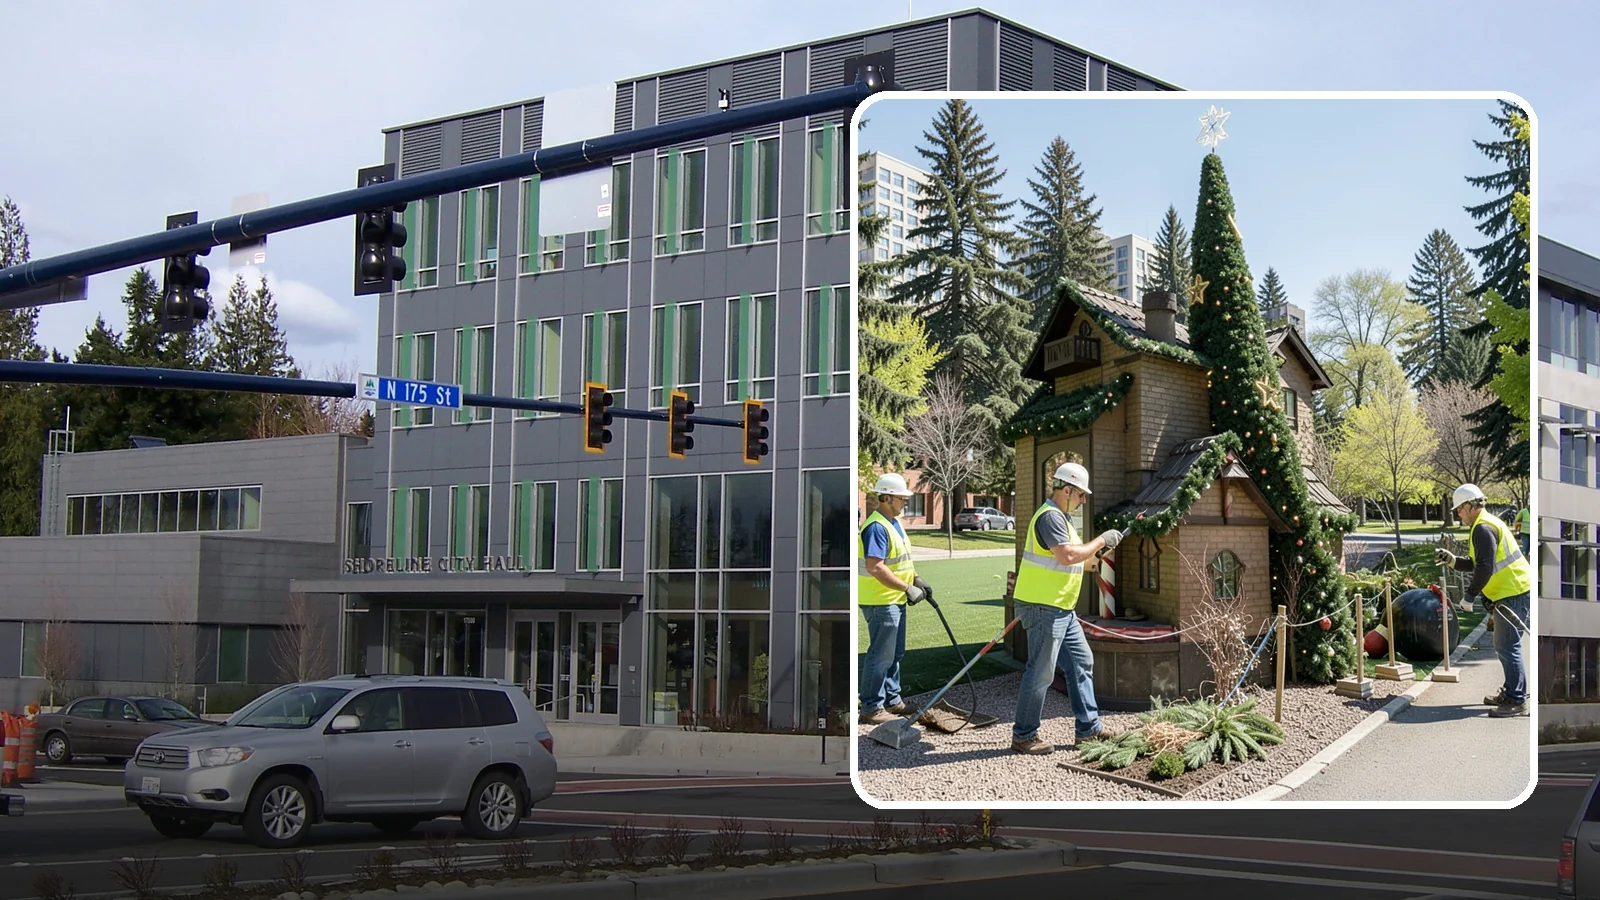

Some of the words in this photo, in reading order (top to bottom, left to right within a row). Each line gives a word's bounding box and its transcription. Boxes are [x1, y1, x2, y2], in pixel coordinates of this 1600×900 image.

[387, 380, 396, 400] N
[405, 382, 427, 403] 175
[436, 386, 451, 406] St
[343, 556, 432, 574] SHORELINE
[438, 556, 475, 572] CITY
[483, 555, 525, 572] HALL
